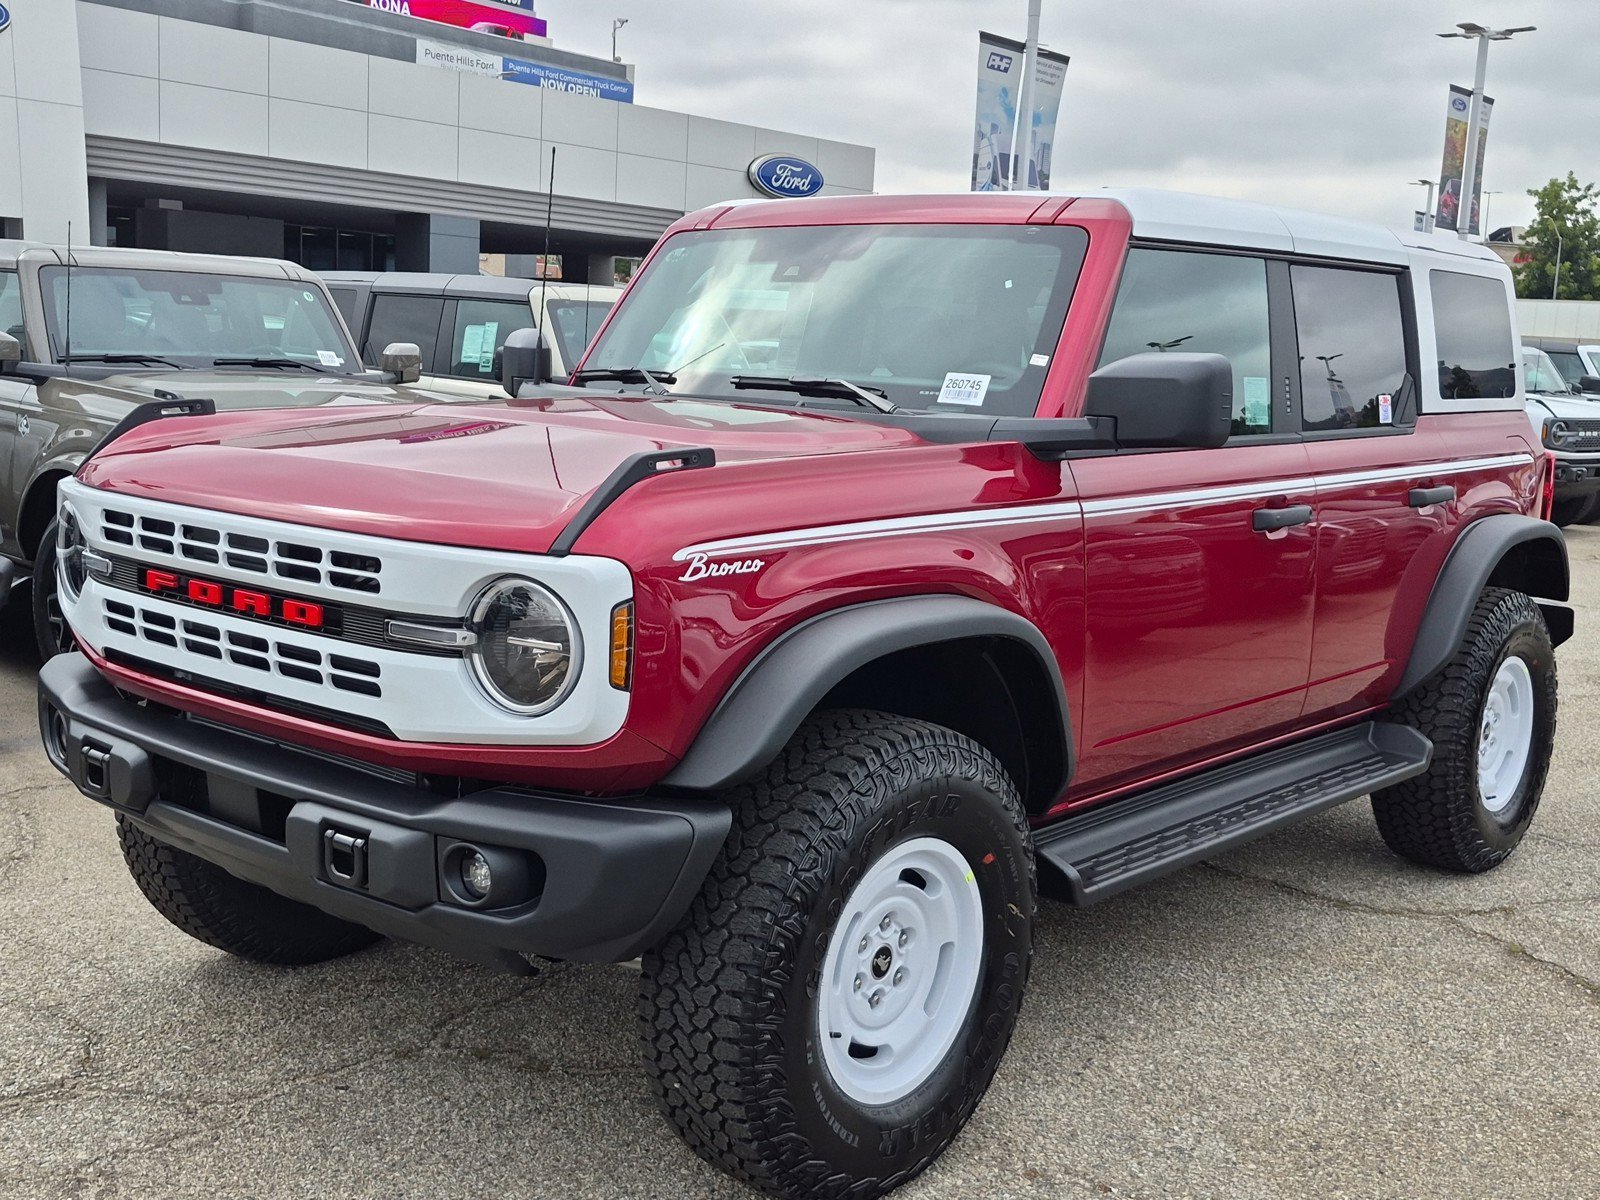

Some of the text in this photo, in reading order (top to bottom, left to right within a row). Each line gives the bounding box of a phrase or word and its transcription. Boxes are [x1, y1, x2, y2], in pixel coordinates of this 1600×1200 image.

[371, 0, 411, 16] KONA
[424, 48, 455, 63] Puente
[456, 55, 475, 67] Hills
[475, 59, 495, 70] Ford
[508, 62, 628, 94] Puente Hills Ford Commercial Truck Center
[540, 77, 600, 98] NOW OPEN!
[771, 163, 812, 191] Ford
[945, 378, 982, 391] 260745
[678, 552, 765, 582] Bronco
[146, 569, 323, 627] FORD
[812, 1080, 859, 1148] TERRITORY
